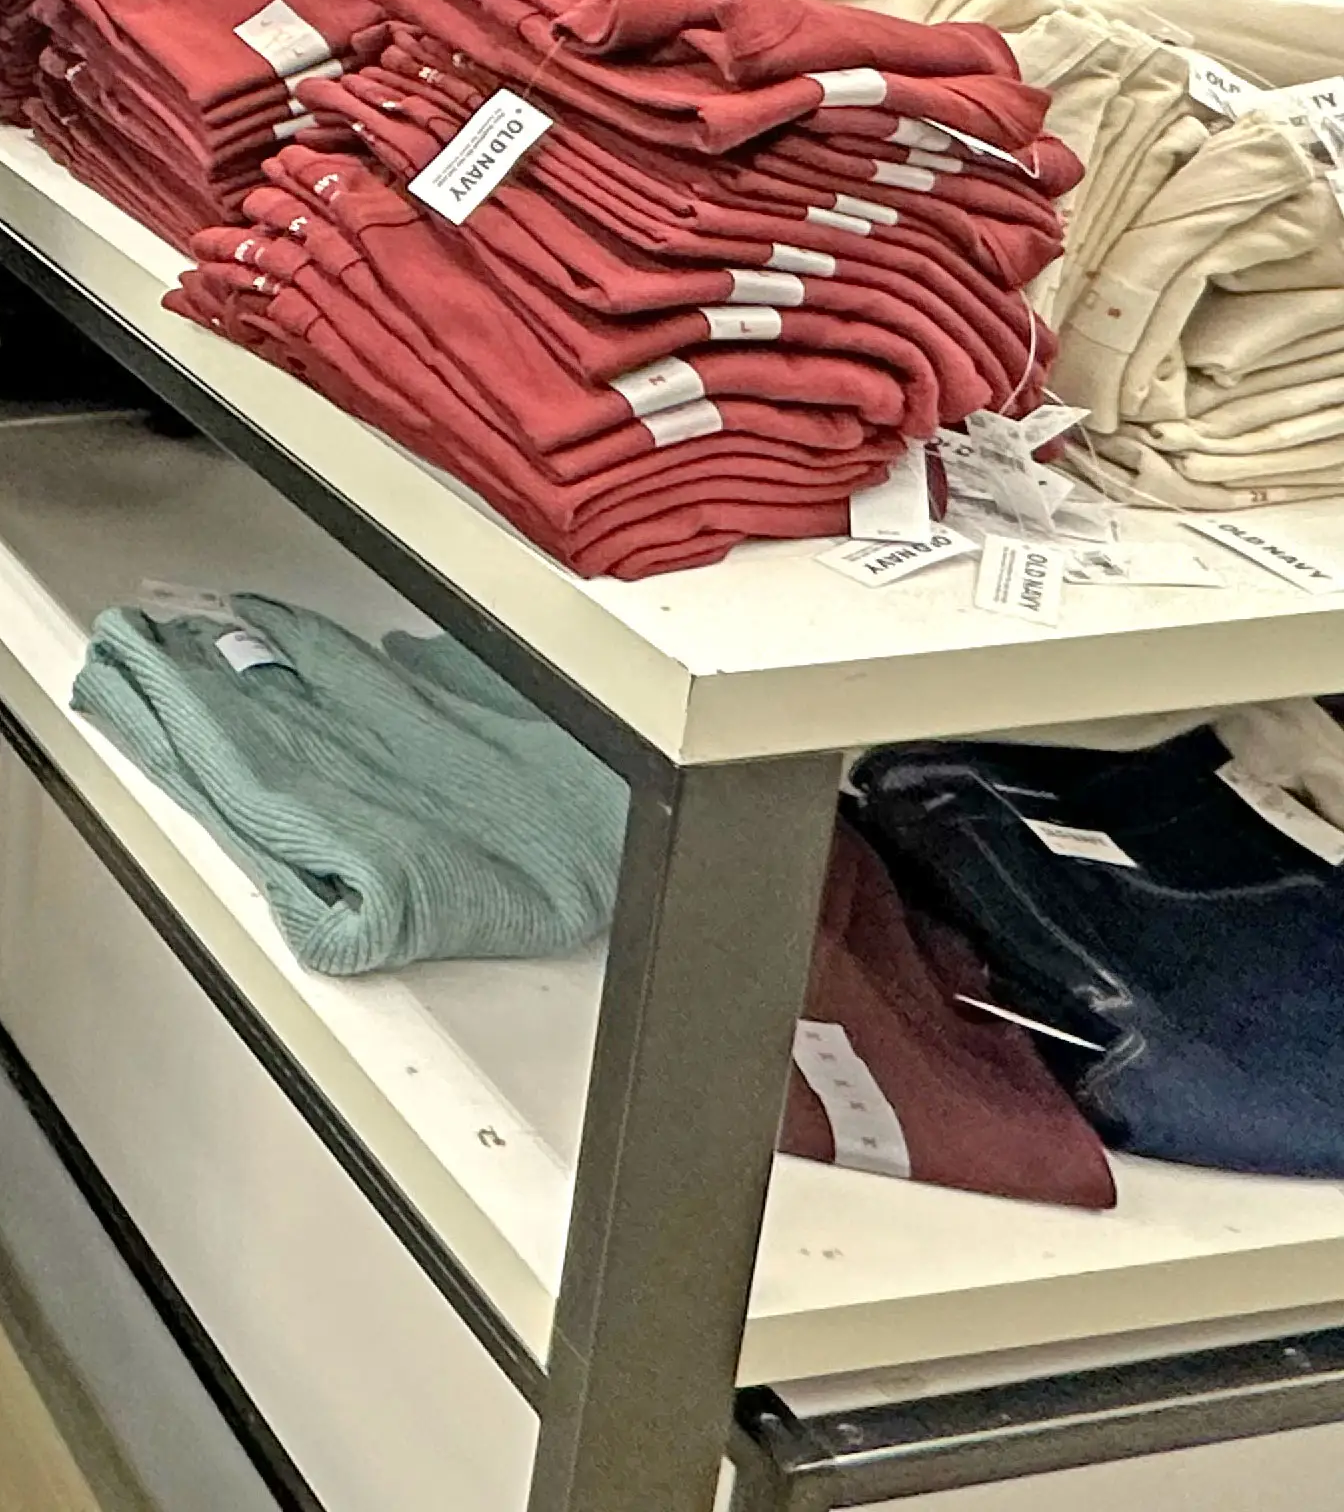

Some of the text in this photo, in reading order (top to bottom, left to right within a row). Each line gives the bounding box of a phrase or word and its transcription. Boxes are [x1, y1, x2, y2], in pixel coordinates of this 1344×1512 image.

[449, 119, 524, 202] OLD NAVY
[863, 547, 917, 575] NAVY
[1218, 524, 1333, 580] OLD NAVY
[1017, 551, 1048, 612] OLD NAVY
